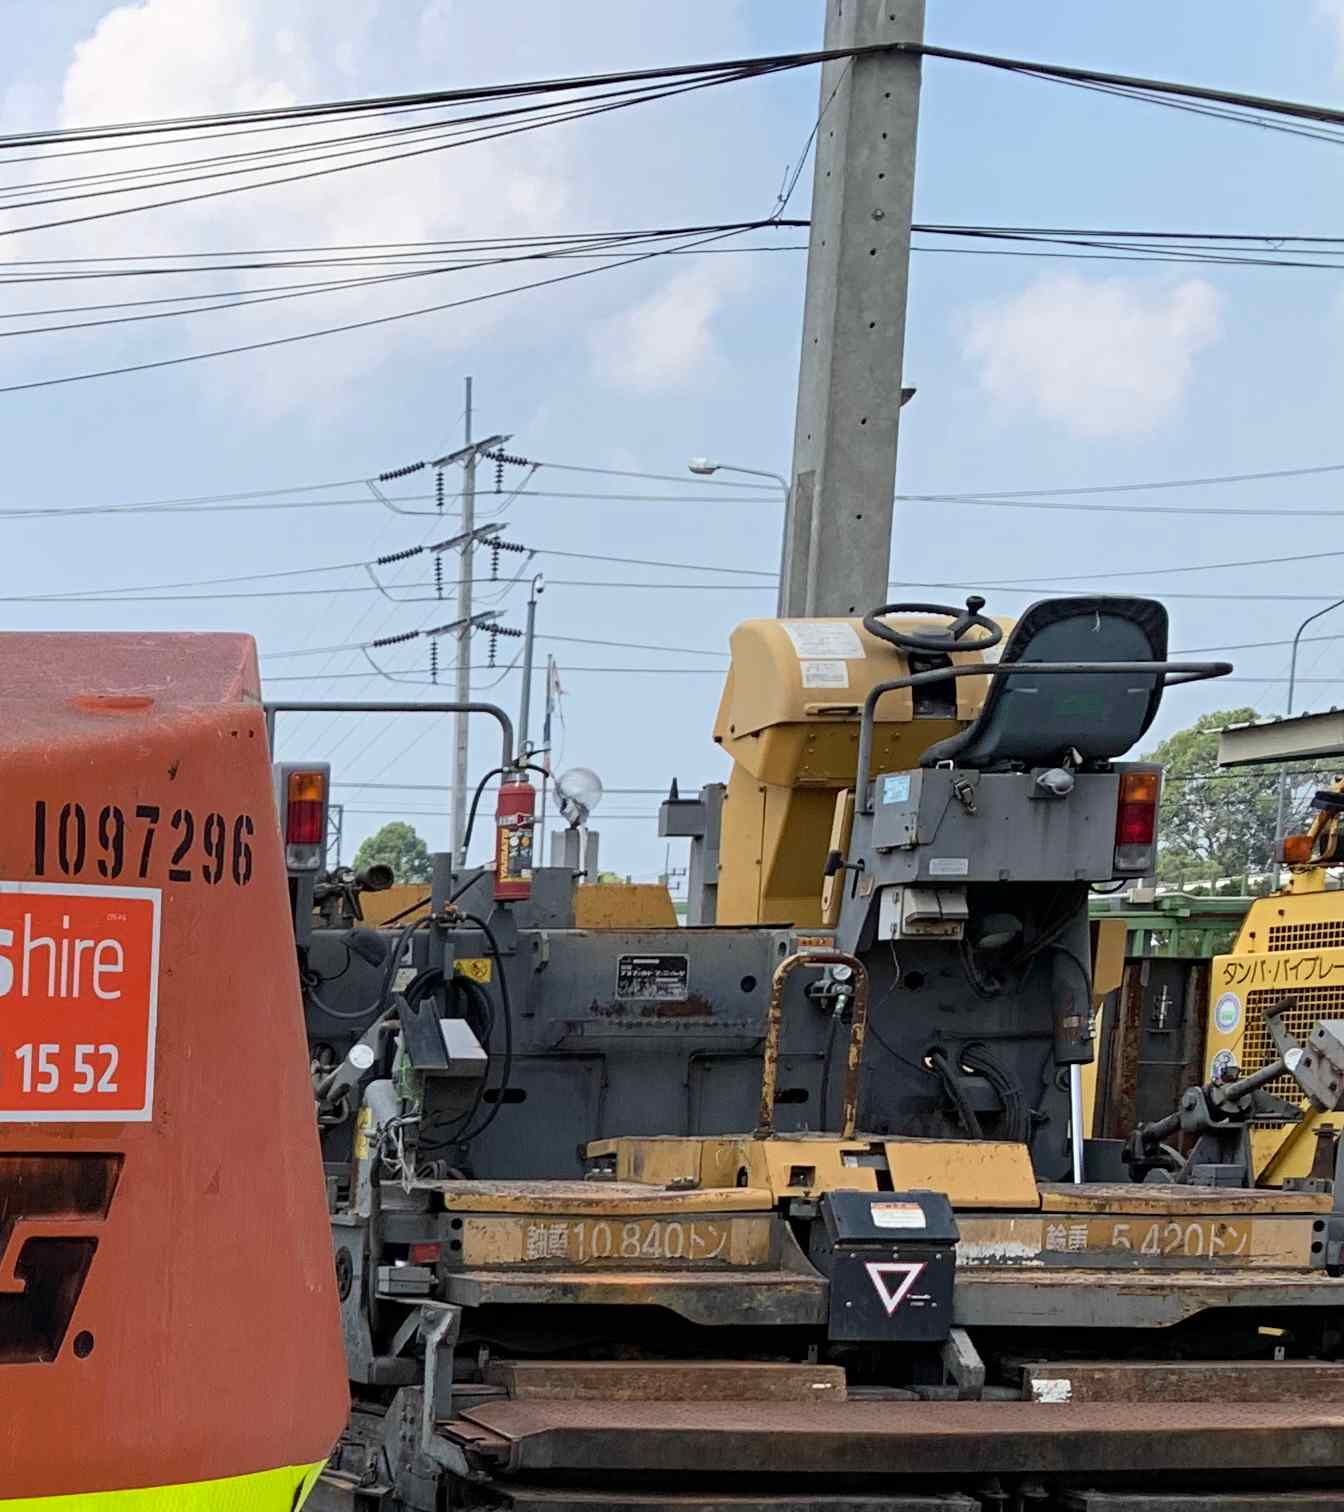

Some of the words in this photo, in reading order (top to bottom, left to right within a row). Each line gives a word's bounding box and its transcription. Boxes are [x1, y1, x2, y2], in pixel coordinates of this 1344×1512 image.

[34, 800, 255, 886] 1097296
[15, 1043, 60, 1094] 15
[73, 1043, 119, 1094] 52
